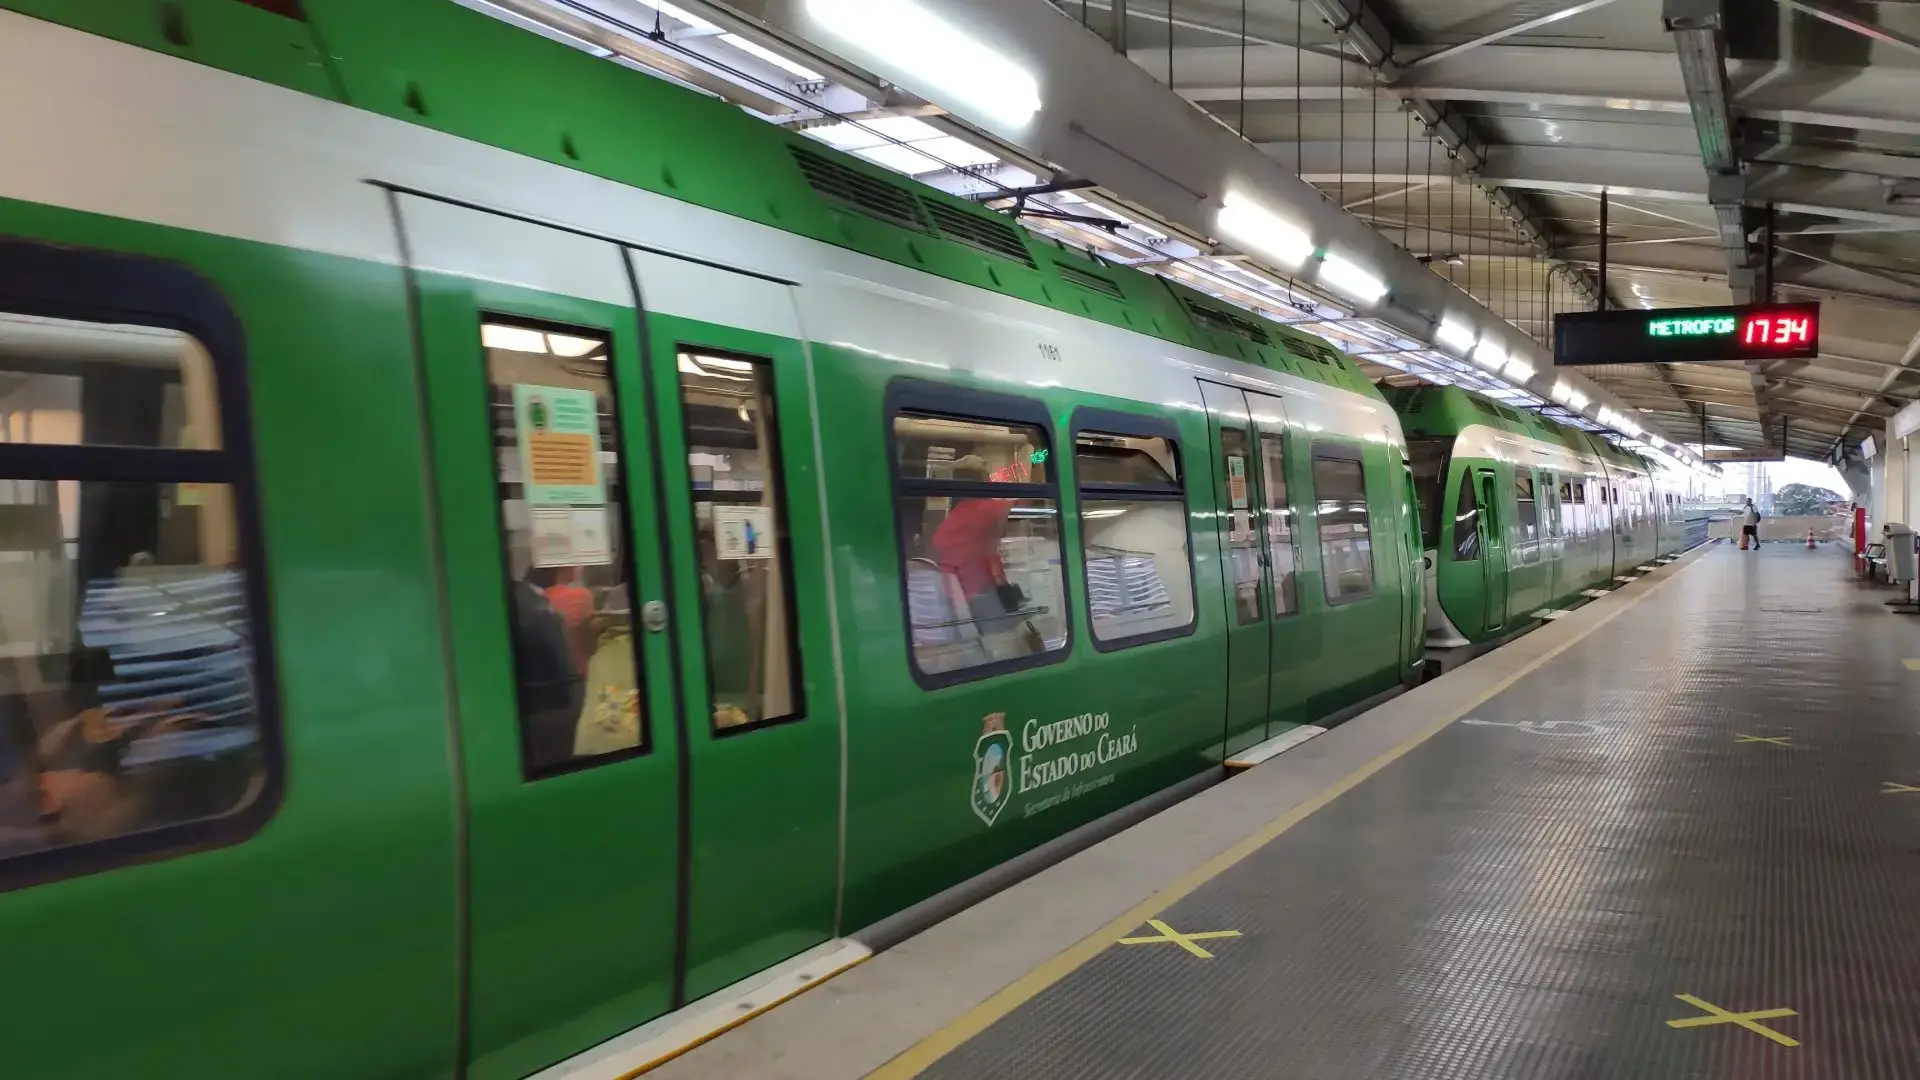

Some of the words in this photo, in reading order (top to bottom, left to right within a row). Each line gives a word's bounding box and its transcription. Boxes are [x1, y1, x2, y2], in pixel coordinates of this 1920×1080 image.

[1018, 752, 1079, 794] ESTADO
[1097, 723, 1138, 765] CEARÁ
[1022, 712, 1093, 753] GOVERNO
